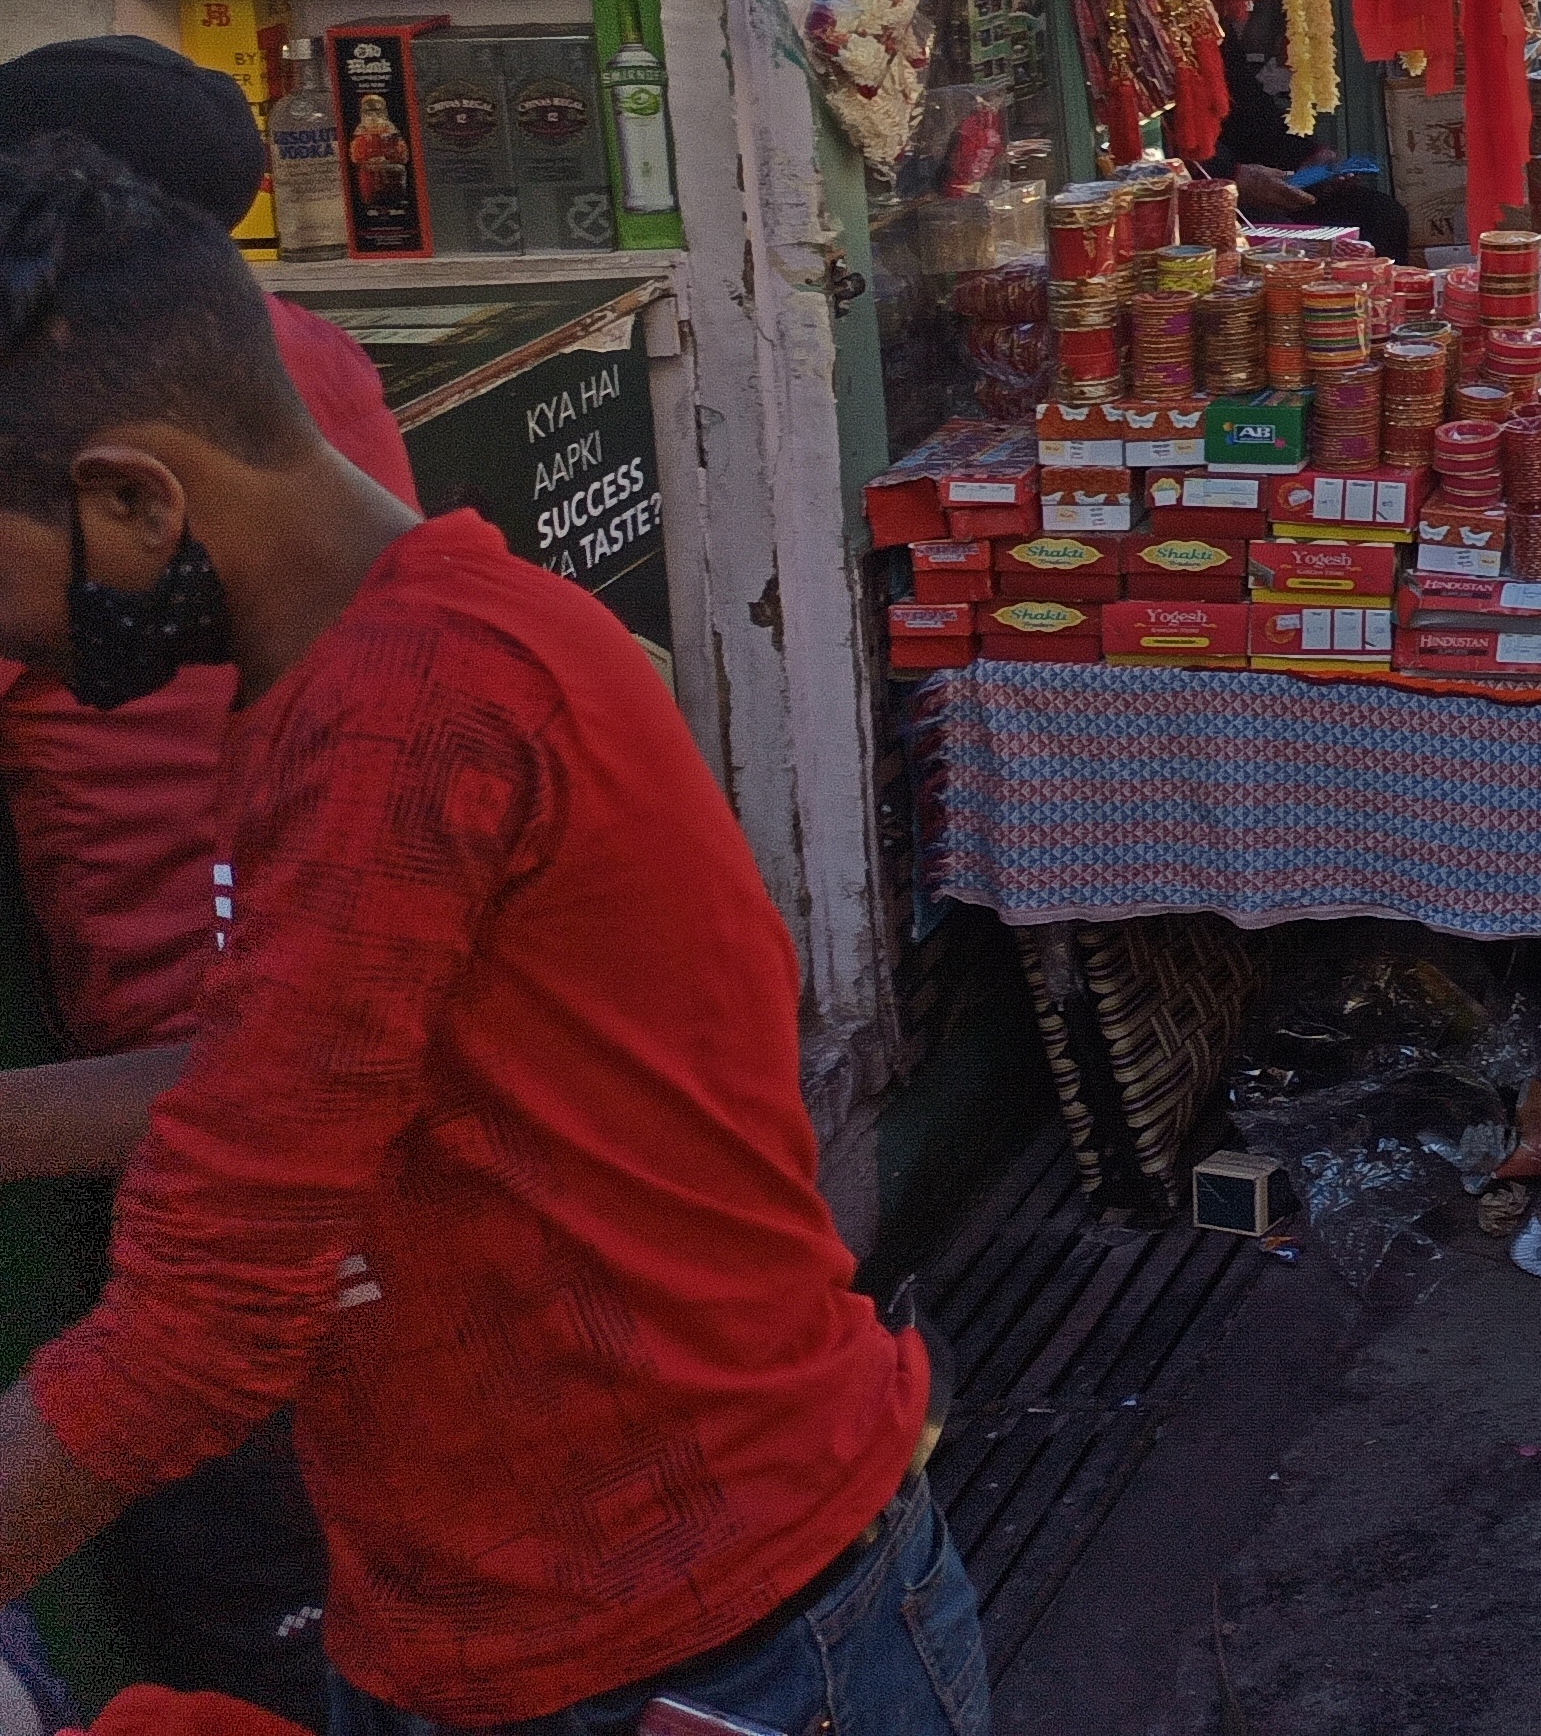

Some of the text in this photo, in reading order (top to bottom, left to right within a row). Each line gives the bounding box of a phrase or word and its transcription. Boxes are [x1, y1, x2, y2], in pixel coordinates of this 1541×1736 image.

[526, 364, 620, 444] KYA HAI
[1238, 425, 1273, 440] AB
[533, 430, 602, 500] AAPKI
[537, 457, 645, 549] SUCCESS
[580, 492, 663, 569] TASTE?
[1025, 544, 1085, 561] Shakti
[1156, 547, 1214, 562] Shakti
[1292, 550, 1353, 568] Yogesh
[1423, 579, 1494, 592] HINDUSTAN
[1011, 609, 1069, 624] Shakti
[1145, 608, 1208, 625] Yogesh
[1418, 634, 1490, 649] HINDUSTAN
